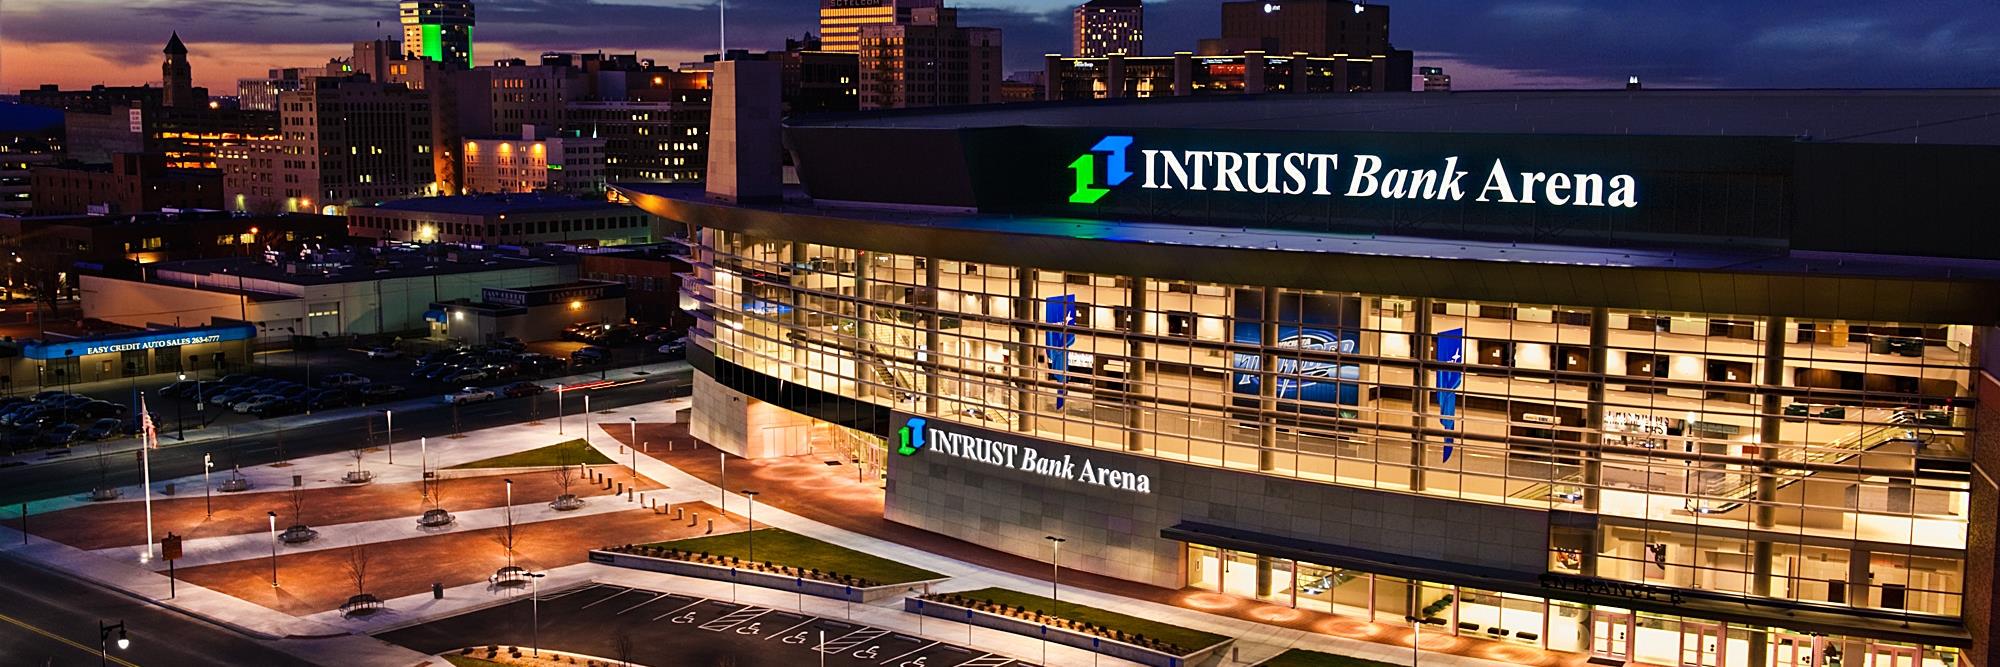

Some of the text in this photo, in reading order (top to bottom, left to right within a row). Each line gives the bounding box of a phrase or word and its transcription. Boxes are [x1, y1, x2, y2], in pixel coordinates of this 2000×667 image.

[1141, 149, 1638, 208] INTRUST Bank Arena
[87, 346, 109, 355] EASY
[109, 342, 141, 353] CREDIT
[142, 340, 165, 349] AUTO
[166, 337, 190, 346] SALES
[928, 428, 1151, 494] INTRUST Bank Arena
[1540, 575, 1657, 601] ENTRANCE
